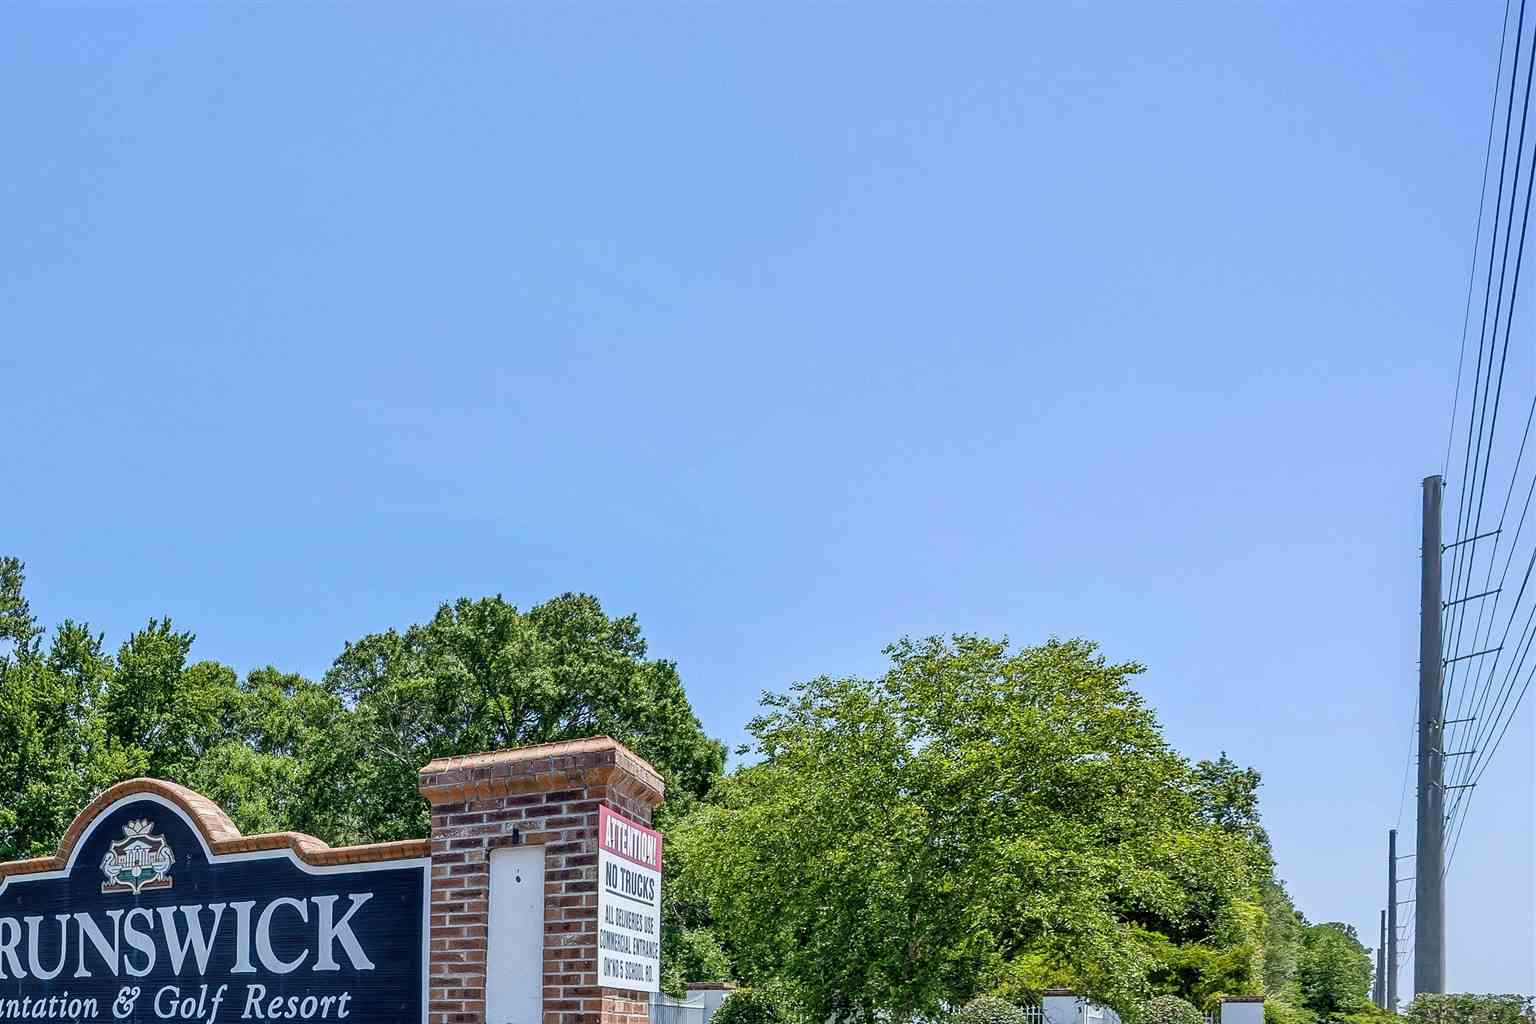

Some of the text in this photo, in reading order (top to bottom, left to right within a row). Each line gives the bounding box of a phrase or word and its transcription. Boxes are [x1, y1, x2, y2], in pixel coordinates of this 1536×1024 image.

[605, 814, 656, 865] ATTENTION!
[606, 861, 655, 900] NO TRUCKS
[605, 904, 653, 935] ALL DELIVERIES USE
[600, 929, 658, 959] COMMERCIAL ENTRANCE
[625, 961, 644, 981] SCHOOL
[112, 986, 140, 1018] &
[241, 985, 353, 1020] Resort
